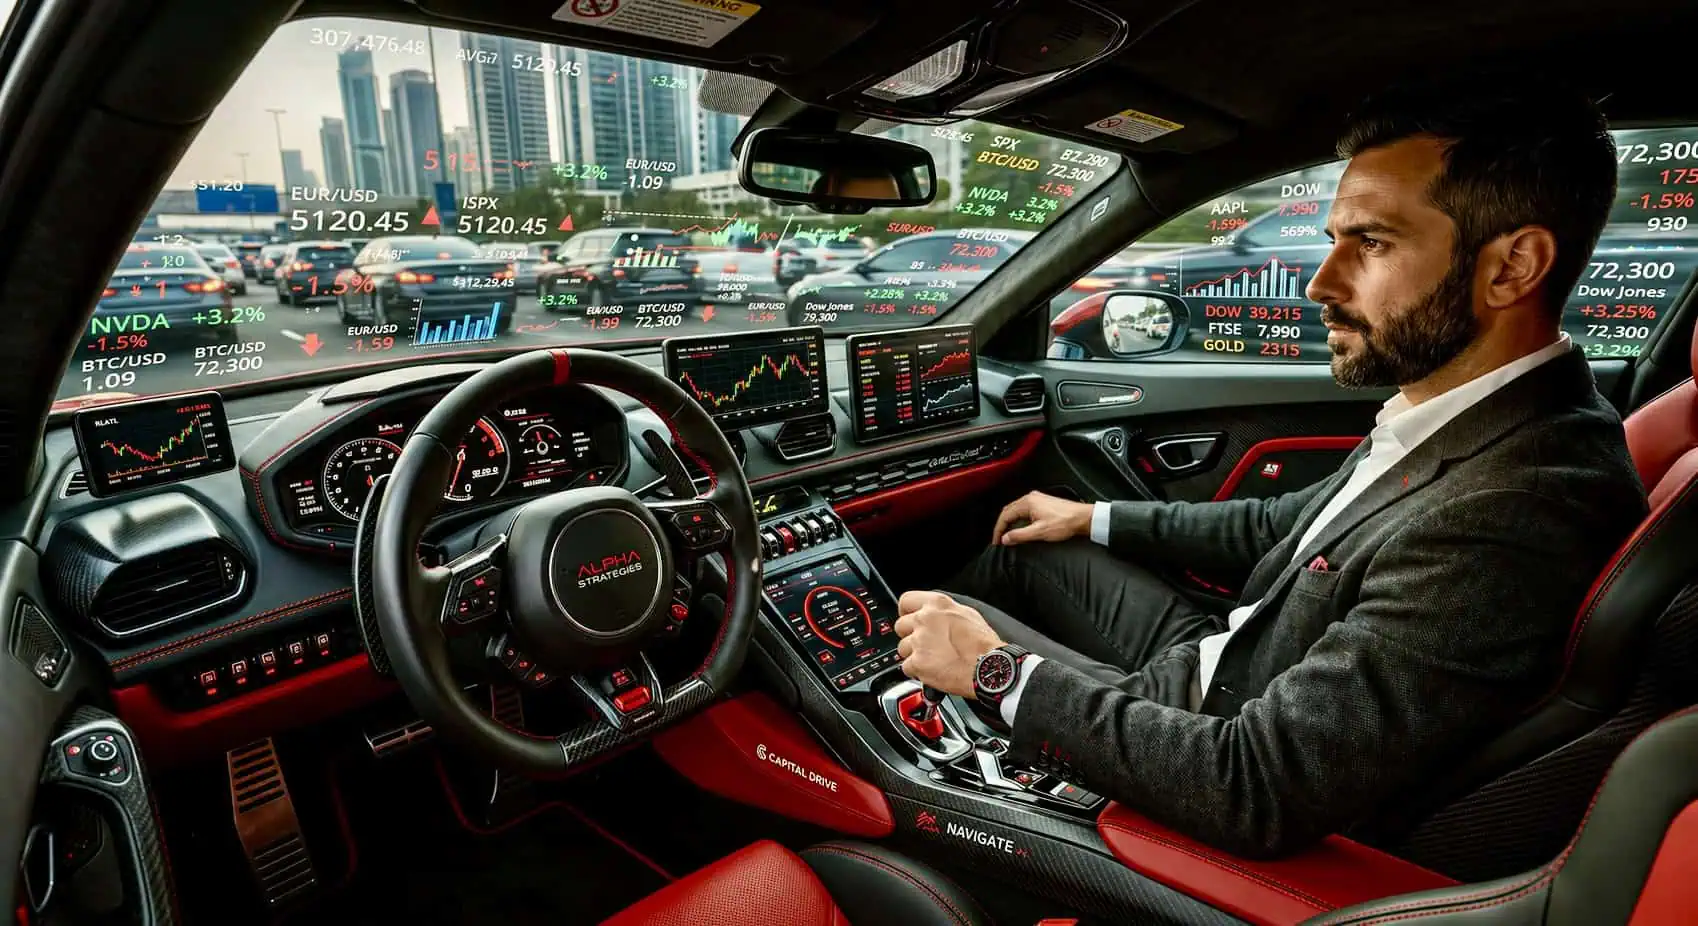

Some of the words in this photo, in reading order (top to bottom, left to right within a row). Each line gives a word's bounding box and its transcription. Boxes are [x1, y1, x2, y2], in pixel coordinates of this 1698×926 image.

[577, 550, 641, 577] ALPHA
[577, 562, 643, 589] STRATEGIES
[768, 753, 807, 778] CAPITAL
[808, 771, 838, 793] DRIVE
[947, 822, 1015, 854] NAVIGATE
